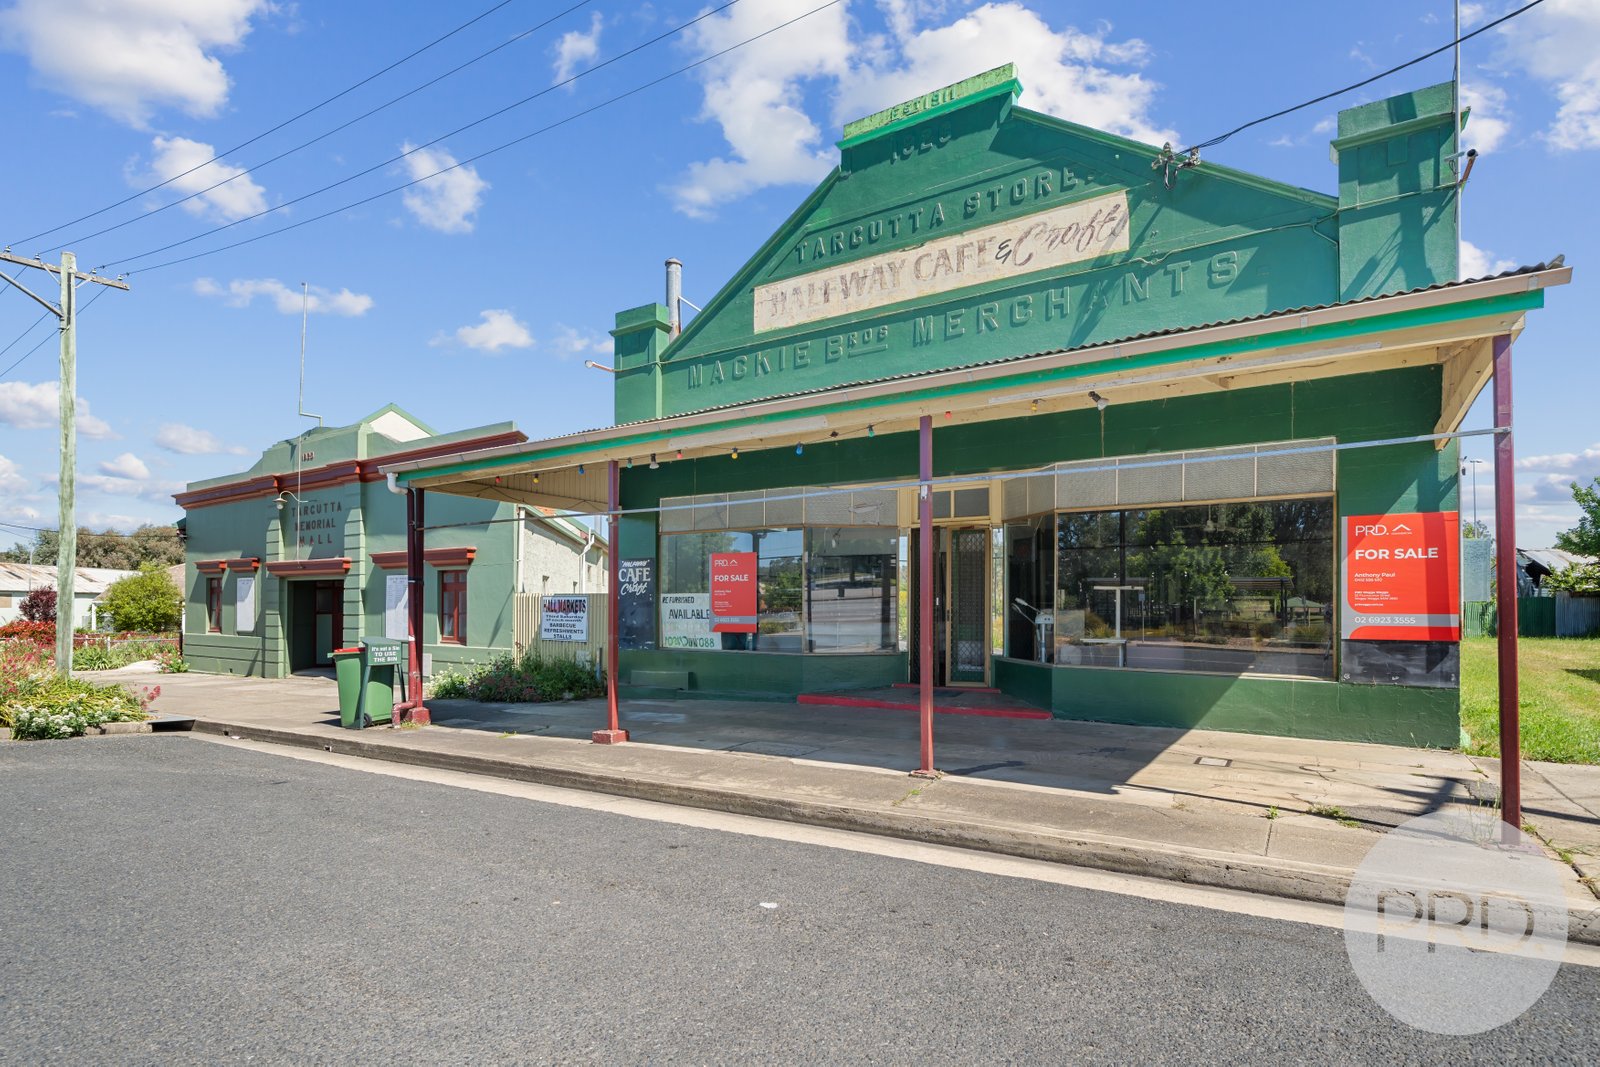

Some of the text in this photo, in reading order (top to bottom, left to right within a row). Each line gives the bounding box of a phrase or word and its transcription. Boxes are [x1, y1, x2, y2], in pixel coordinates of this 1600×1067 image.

[795, 202, 945, 262] TARCUTTA
[913, 235, 997, 281] CAFE
[995, 238, 1013, 264] &
[688, 341, 811, 389] MACKIE
[914, 250, 1238, 347] MERCHANTS
[291, 501, 342, 517] TARCUTTA
[298, 533, 333, 546] HALL
[1355, 547, 1439, 560] FOR SALE
[618, 567, 651, 582] CAFE
[714, 574, 749, 582] FOR SALE
[557, 599, 587, 614] MARKETS
[668, 609, 710, 620] AVAILABLE
[1354, 616, 1416, 624] 02 6923 3555
